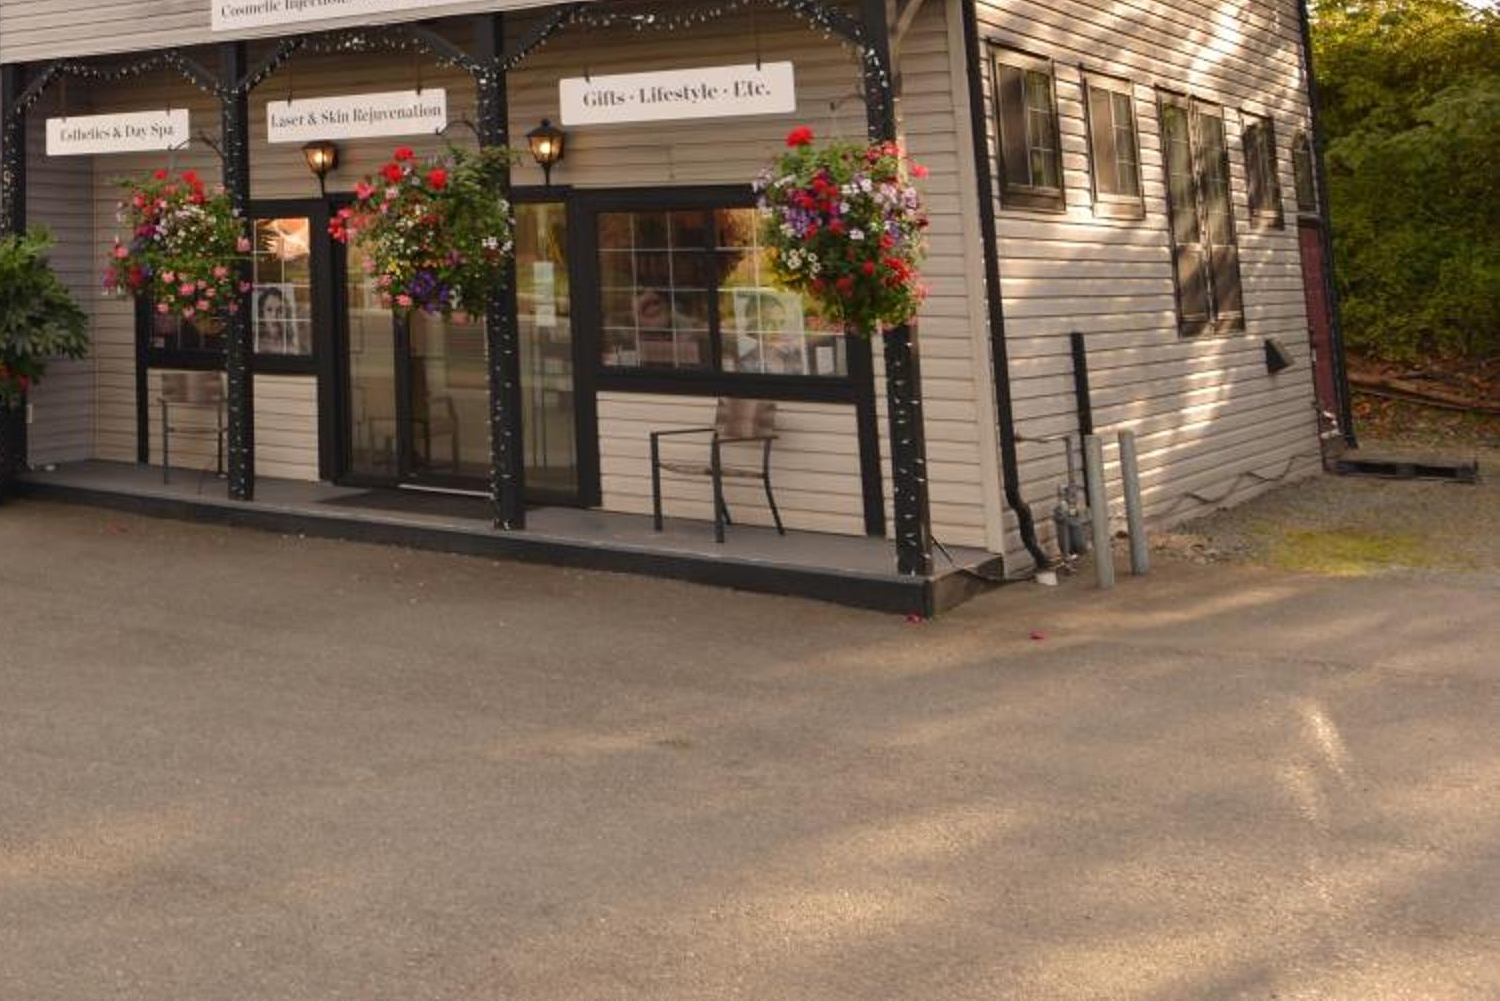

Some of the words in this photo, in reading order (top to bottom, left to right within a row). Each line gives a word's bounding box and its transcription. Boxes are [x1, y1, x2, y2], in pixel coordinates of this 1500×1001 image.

[583, 90, 625, 107] Gifts
[639, 83, 718, 103] Lifestyle
[734, 80, 771, 97] Etc.
[272, 113, 304, 127] Laser
[308, 111, 317, 125] &
[321, 108, 348, 123] Skin
[353, 103, 441, 125] Rejuvenation
[112, 126, 122, 138] &
[125, 125, 147, 140] Day
[151, 122, 173, 137] Spa
